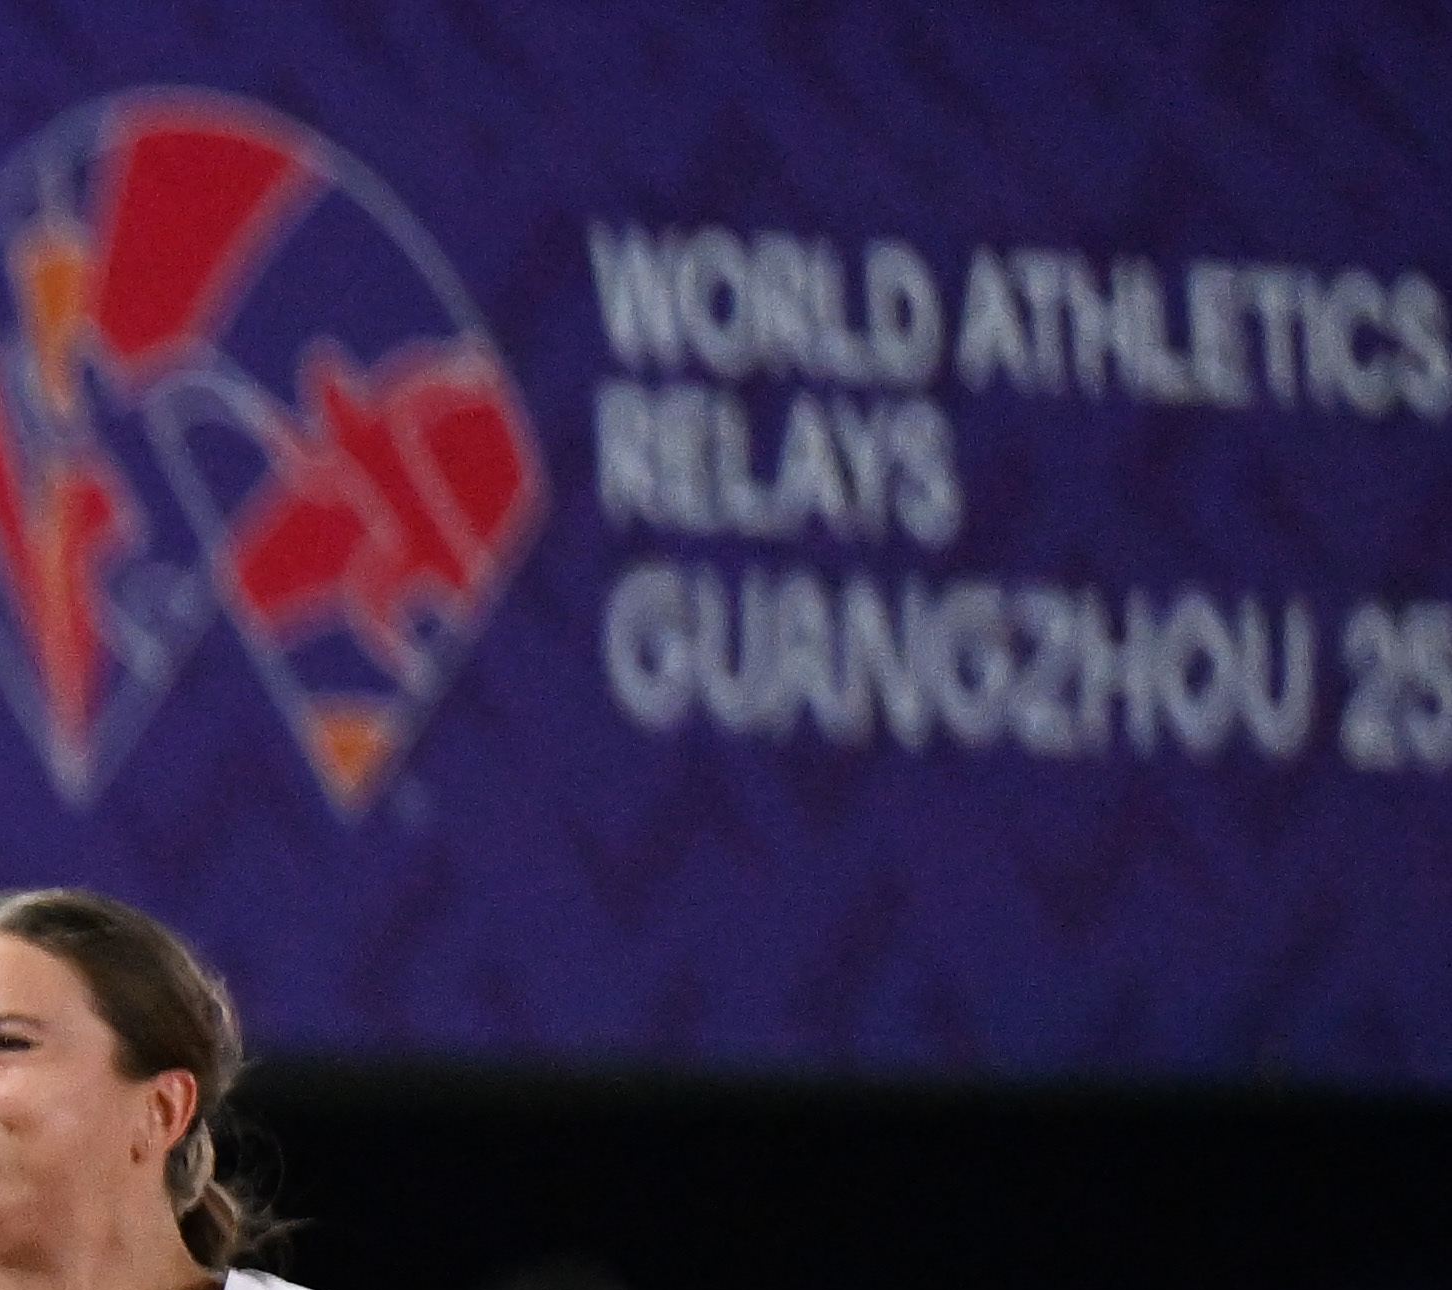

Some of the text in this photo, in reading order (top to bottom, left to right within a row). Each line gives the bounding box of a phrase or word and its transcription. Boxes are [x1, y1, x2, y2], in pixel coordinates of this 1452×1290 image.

[587, 220, 1452, 418] WORLD ATHLETICS
[595, 379, 959, 542] RELAYS
[605, 560, 1452, 769] GUANGZHOU 25
